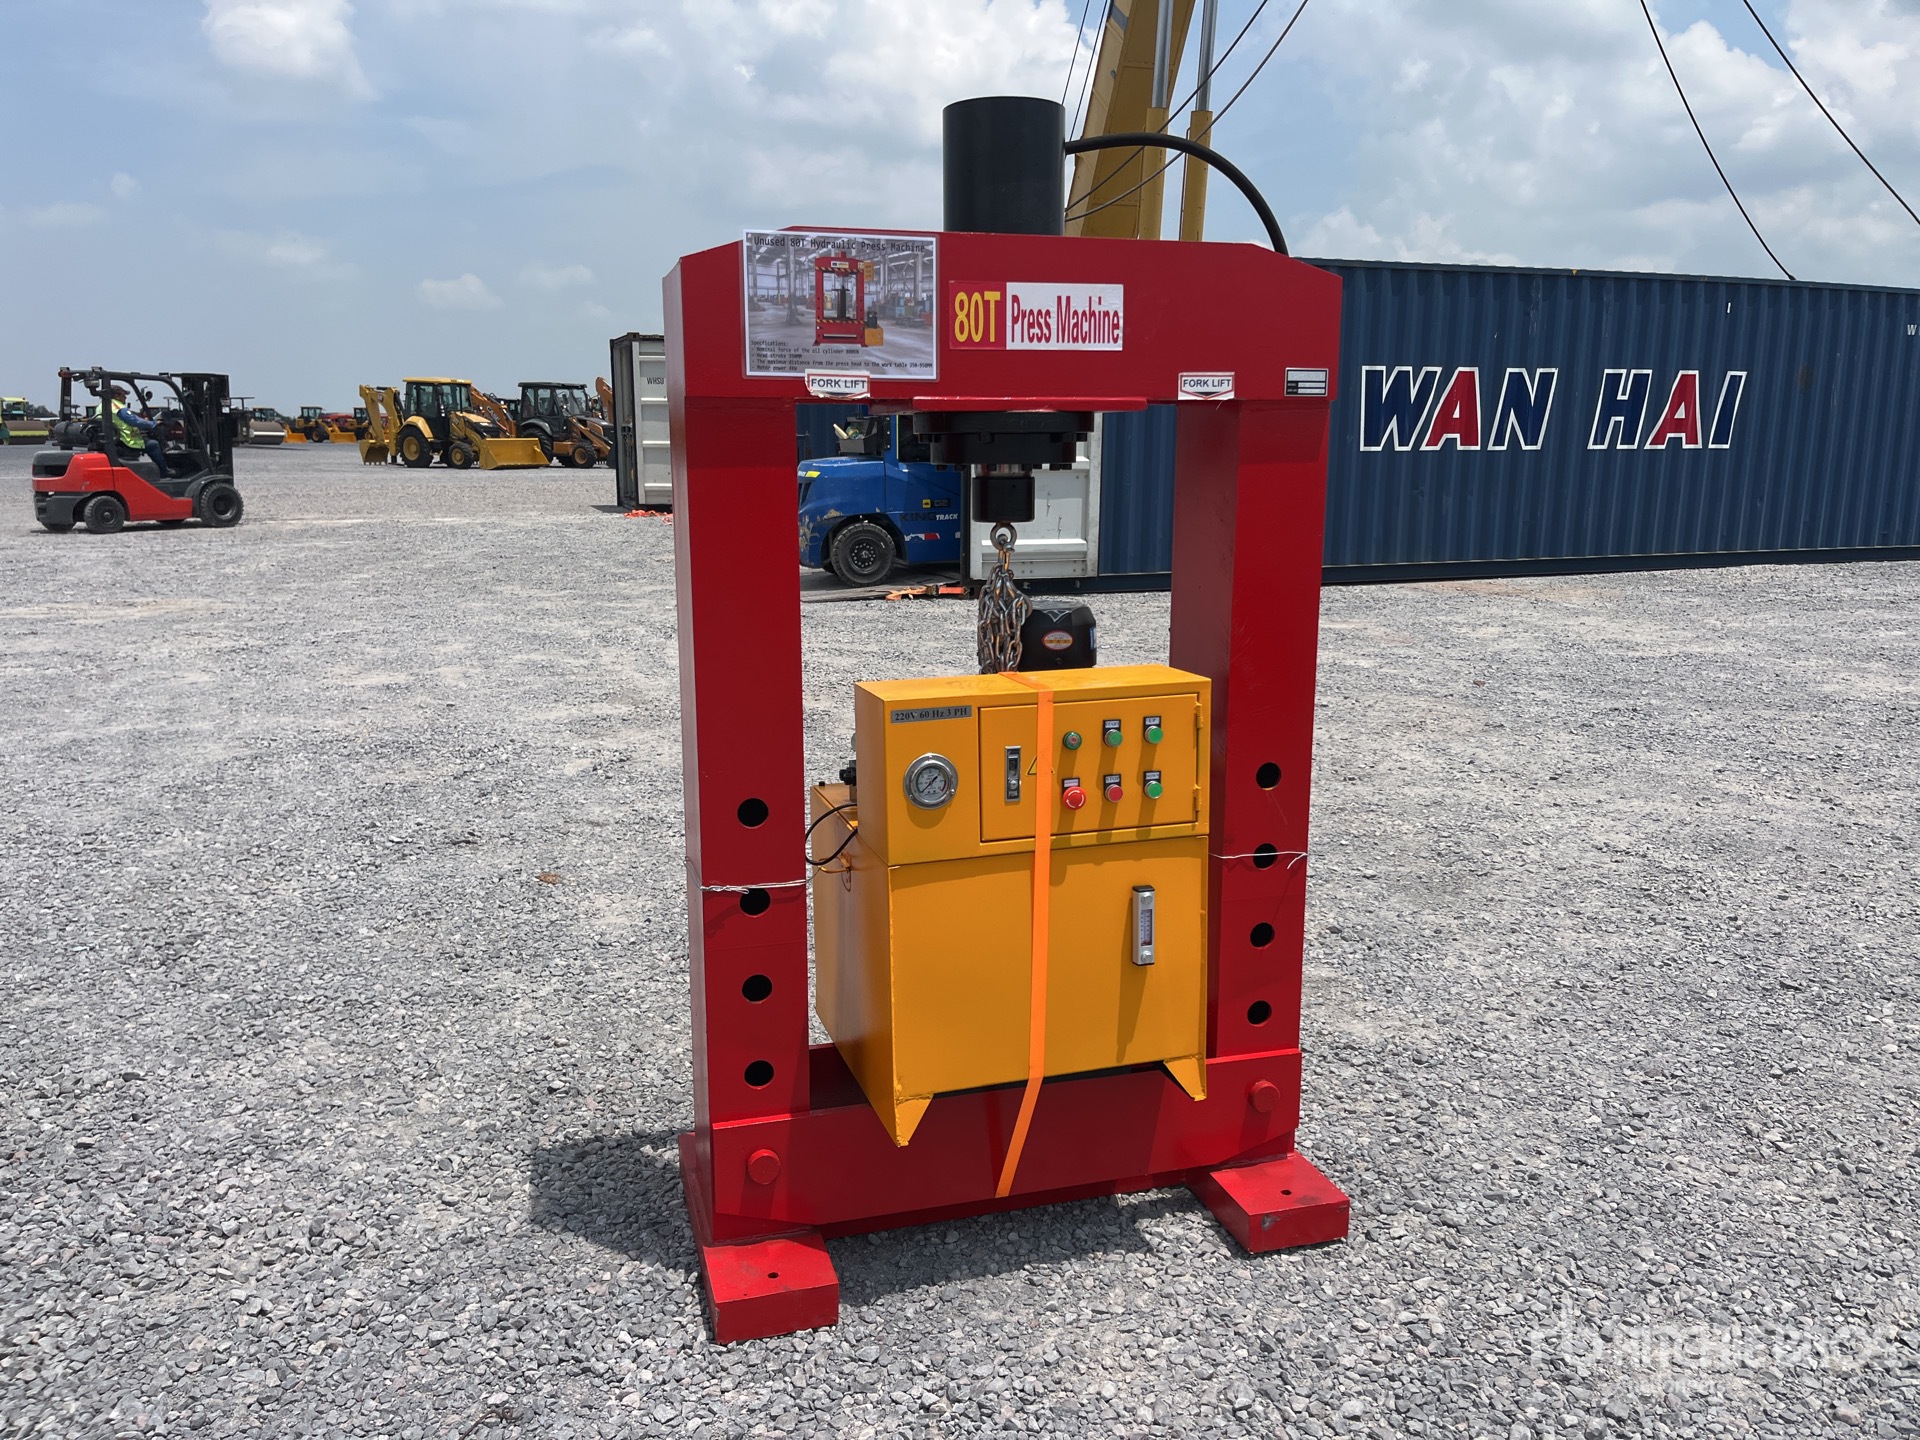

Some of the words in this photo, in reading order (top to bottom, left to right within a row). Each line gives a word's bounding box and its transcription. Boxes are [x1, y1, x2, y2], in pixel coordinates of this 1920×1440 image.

[753, 236, 785, 246] Unused
[790, 238, 806, 248] 80T
[810, 238, 856, 250] Hydraulic
[861, 241, 886, 251] Press
[890, 242, 925, 252] Machine
[954, 290, 1000, 343] 80T
[1011, 294, 1051, 343] Press
[1056, 295, 1120, 344] Machine
[811, 378, 841, 388] FORK
[844, 379, 867, 389] LIFT
[1183, 379, 1209, 388] FORK
[1212, 379, 1231, 388] LIFT
[1359, 365, 1558, 451] WAN
[1587, 368, 1747, 450] HAI
[935, 513, 959, 521] TRACK
[894, 711, 917, 721] 220V
[919, 710, 930, 719] 60
[932, 709, 945, 718] Hz
[946, 708, 951, 717] 3
[954, 707, 967, 716] PH
